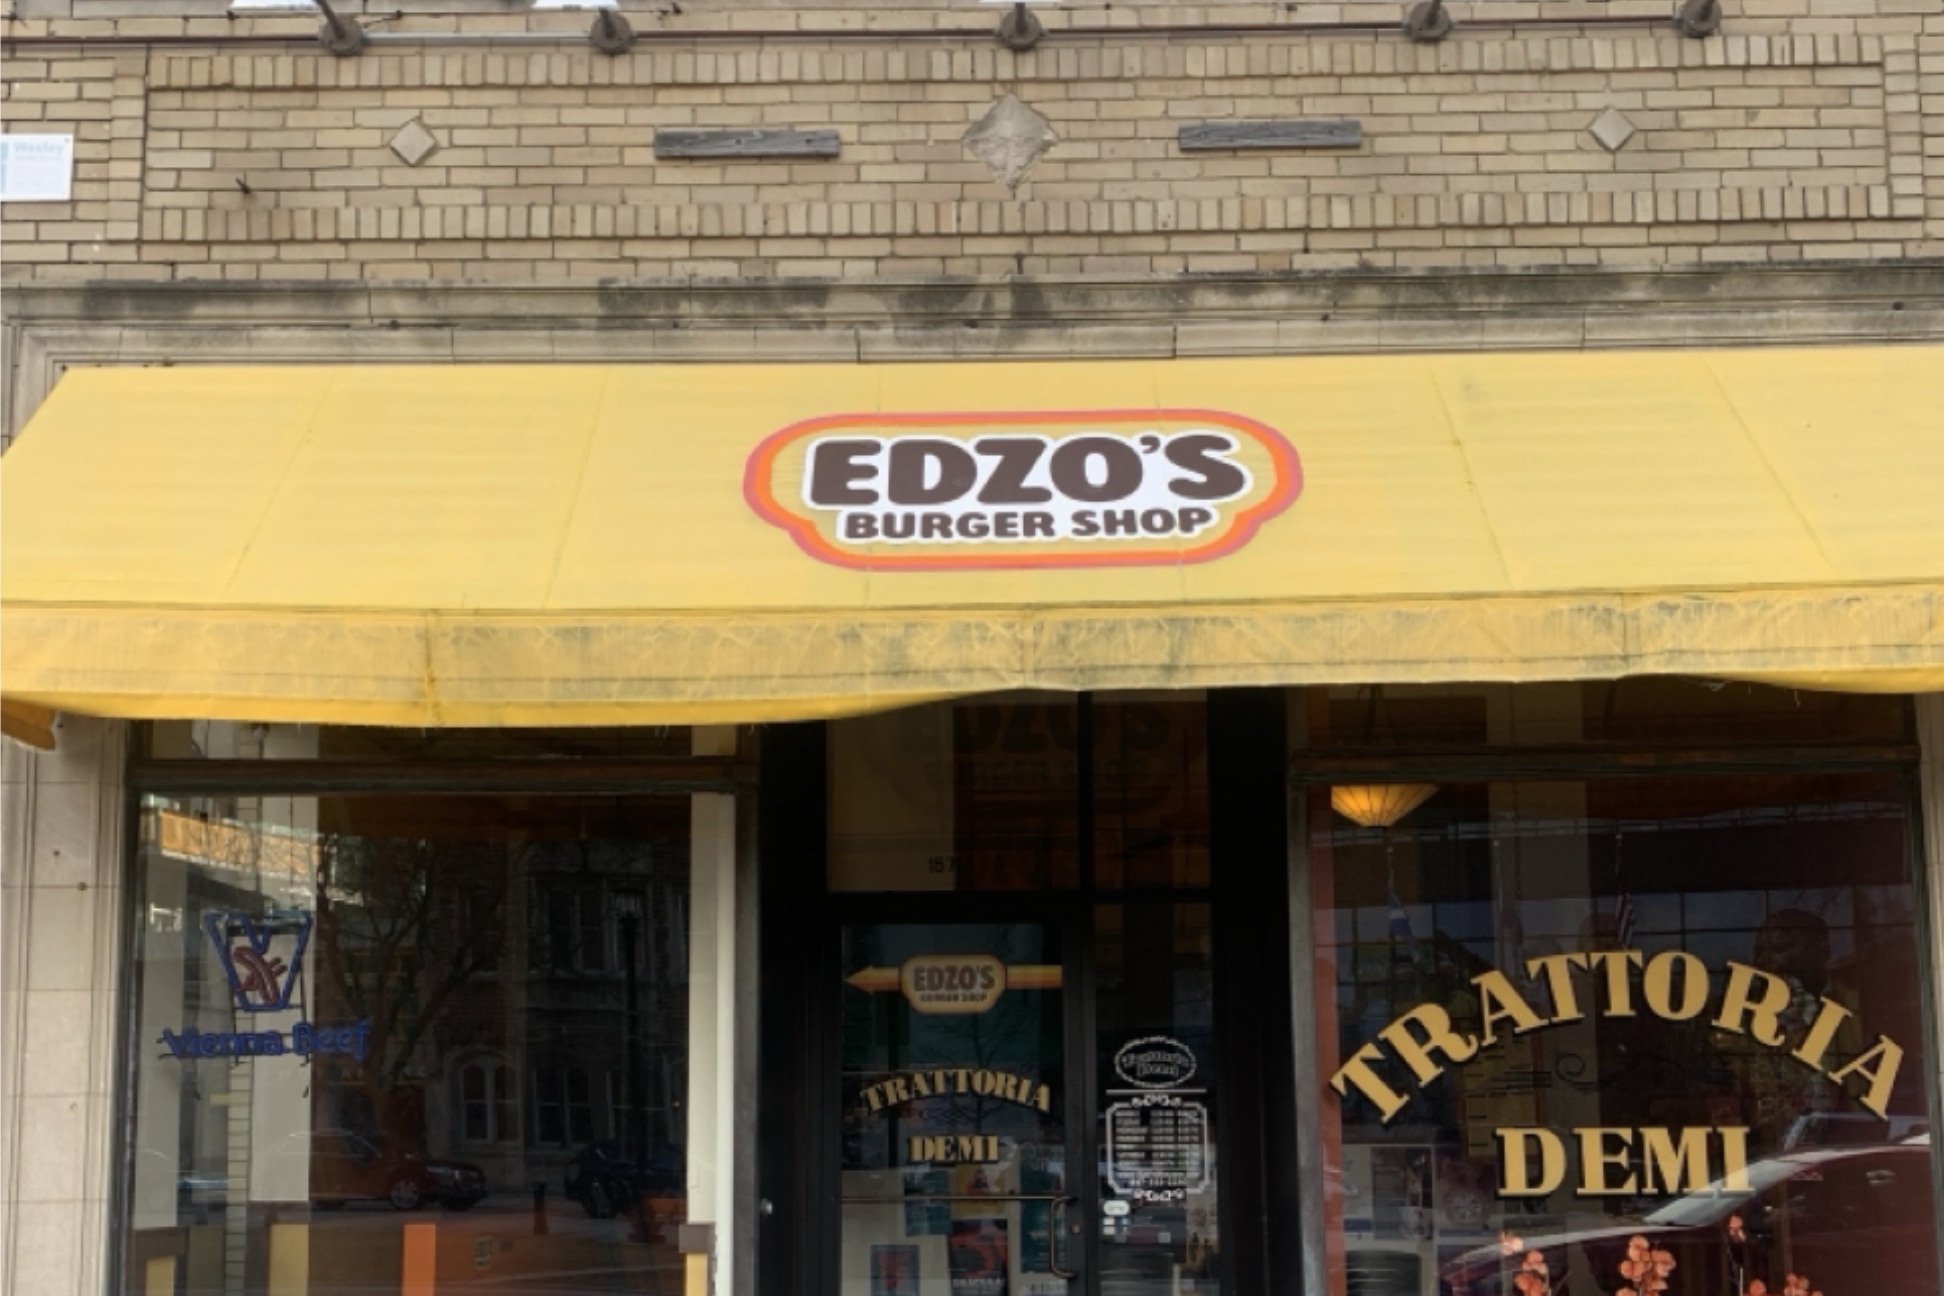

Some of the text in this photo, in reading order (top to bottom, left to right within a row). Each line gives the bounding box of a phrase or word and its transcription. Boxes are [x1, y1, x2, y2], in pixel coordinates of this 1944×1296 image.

[809, 434, 1246, 505] EDZO'S
[844, 507, 1210, 539] BURGER SHOP
[914, 965, 996, 991] EDZO'S
[164, 1018, 372, 1060] Vienna Beef
[1330, 949, 1904, 1122] TRATTORIA
[859, 1068, 1051, 1114] TRATTORIA
[910, 1134, 999, 1161] DEMI
[1495, 1125, 1755, 1197] DEMI
